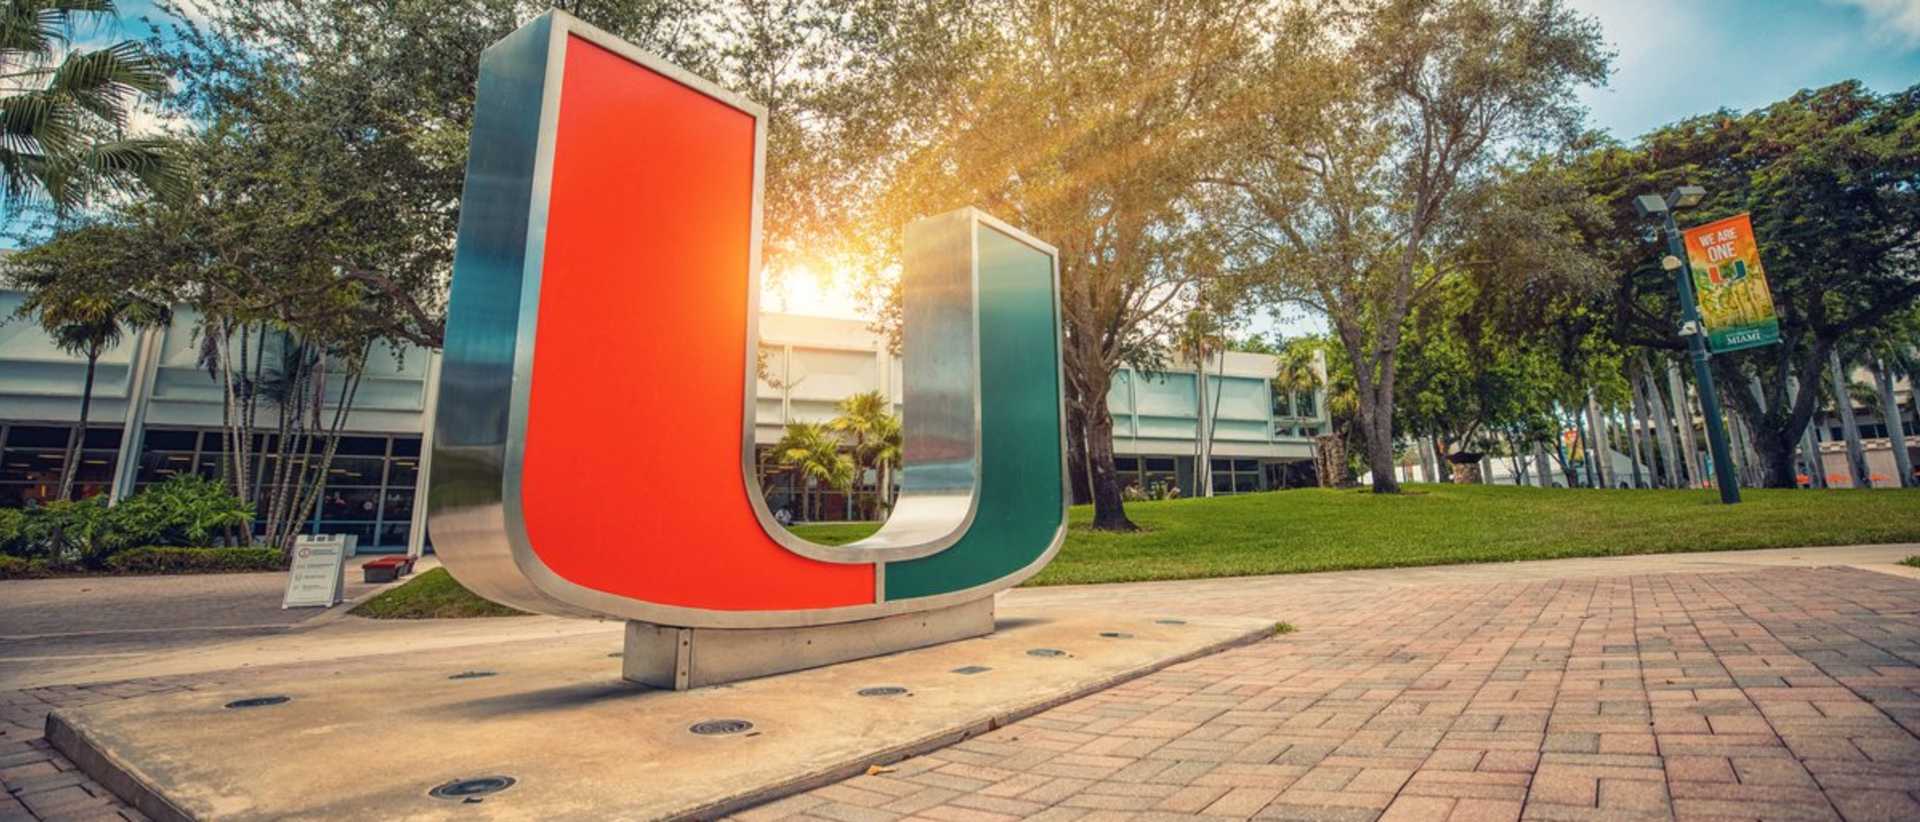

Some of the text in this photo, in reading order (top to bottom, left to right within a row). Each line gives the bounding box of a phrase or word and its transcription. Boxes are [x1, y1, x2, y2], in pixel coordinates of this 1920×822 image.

[1699, 227, 1737, 247] WE ARE
[1708, 242, 1737, 261] ONE
[428, 10, 1068, 625] U
[1726, 333, 1761, 345] MIAMI
